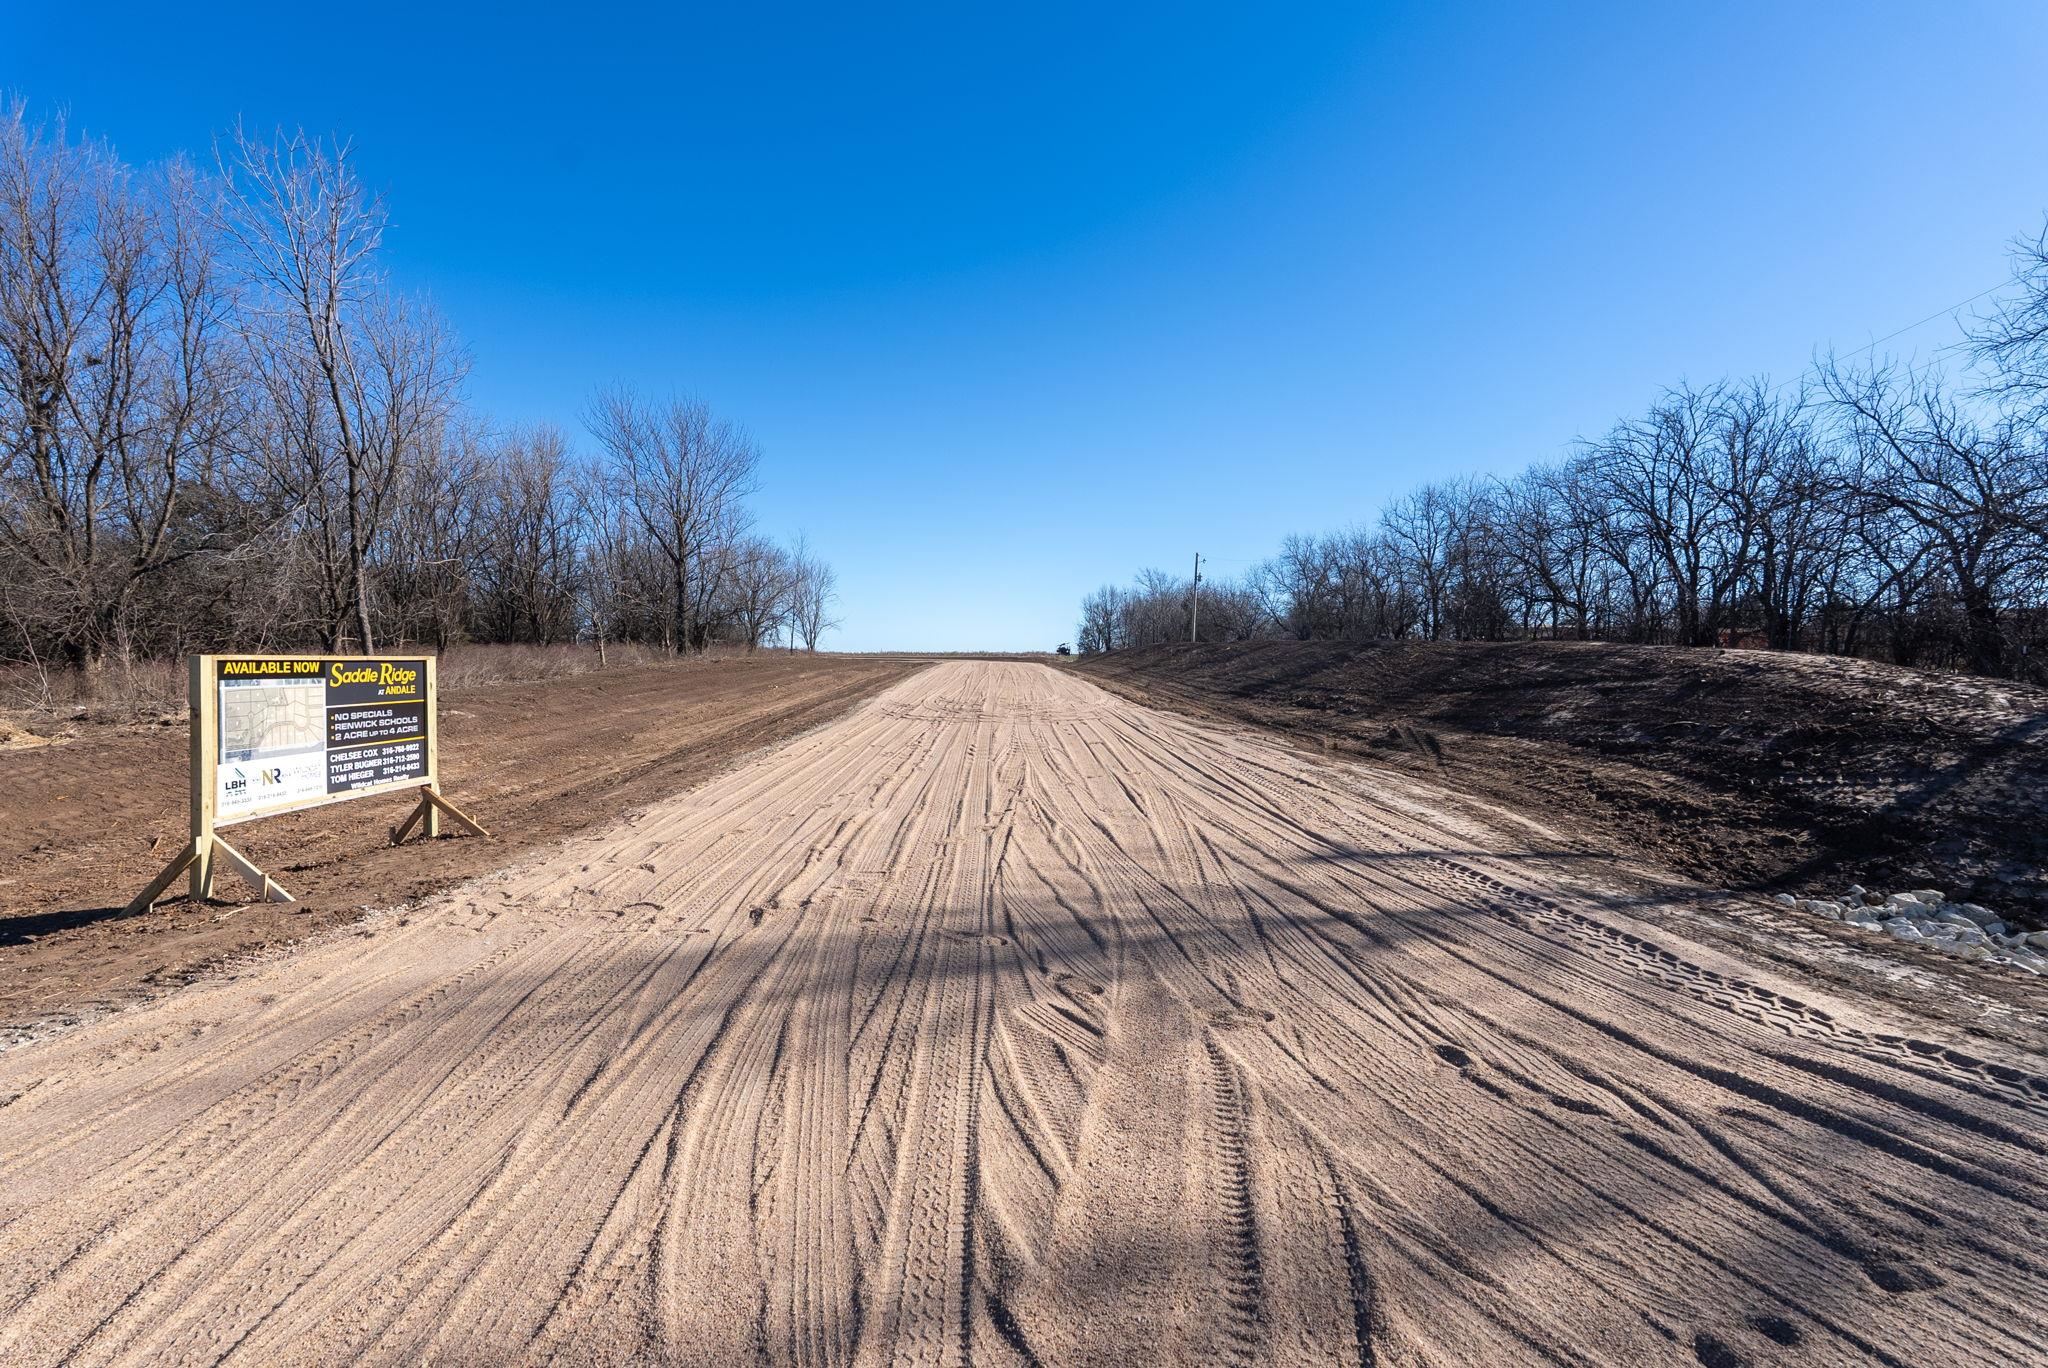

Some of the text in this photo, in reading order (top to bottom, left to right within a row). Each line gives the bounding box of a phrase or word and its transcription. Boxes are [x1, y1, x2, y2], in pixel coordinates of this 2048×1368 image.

[224, 661, 320, 674] AVAILABLE NOW
[329, 662, 417, 687] Saddle Ridge
[385, 685, 416, 695] ANDALE
[334, 709, 393, 721] NO SPECIALS
[334, 716, 418, 731] RENWICK SCHOOLS
[335, 733, 342, 741] 2
[343, 730, 368, 740] ACRE
[396, 725, 418, 733] ACRE
[330, 750, 362, 763] CHELSEE
[363, 748, 378, 758] COX
[330, 762, 353, 773] TYLER
[225, 780, 246, 791] LBH
[330, 775, 347, 784] TOM
